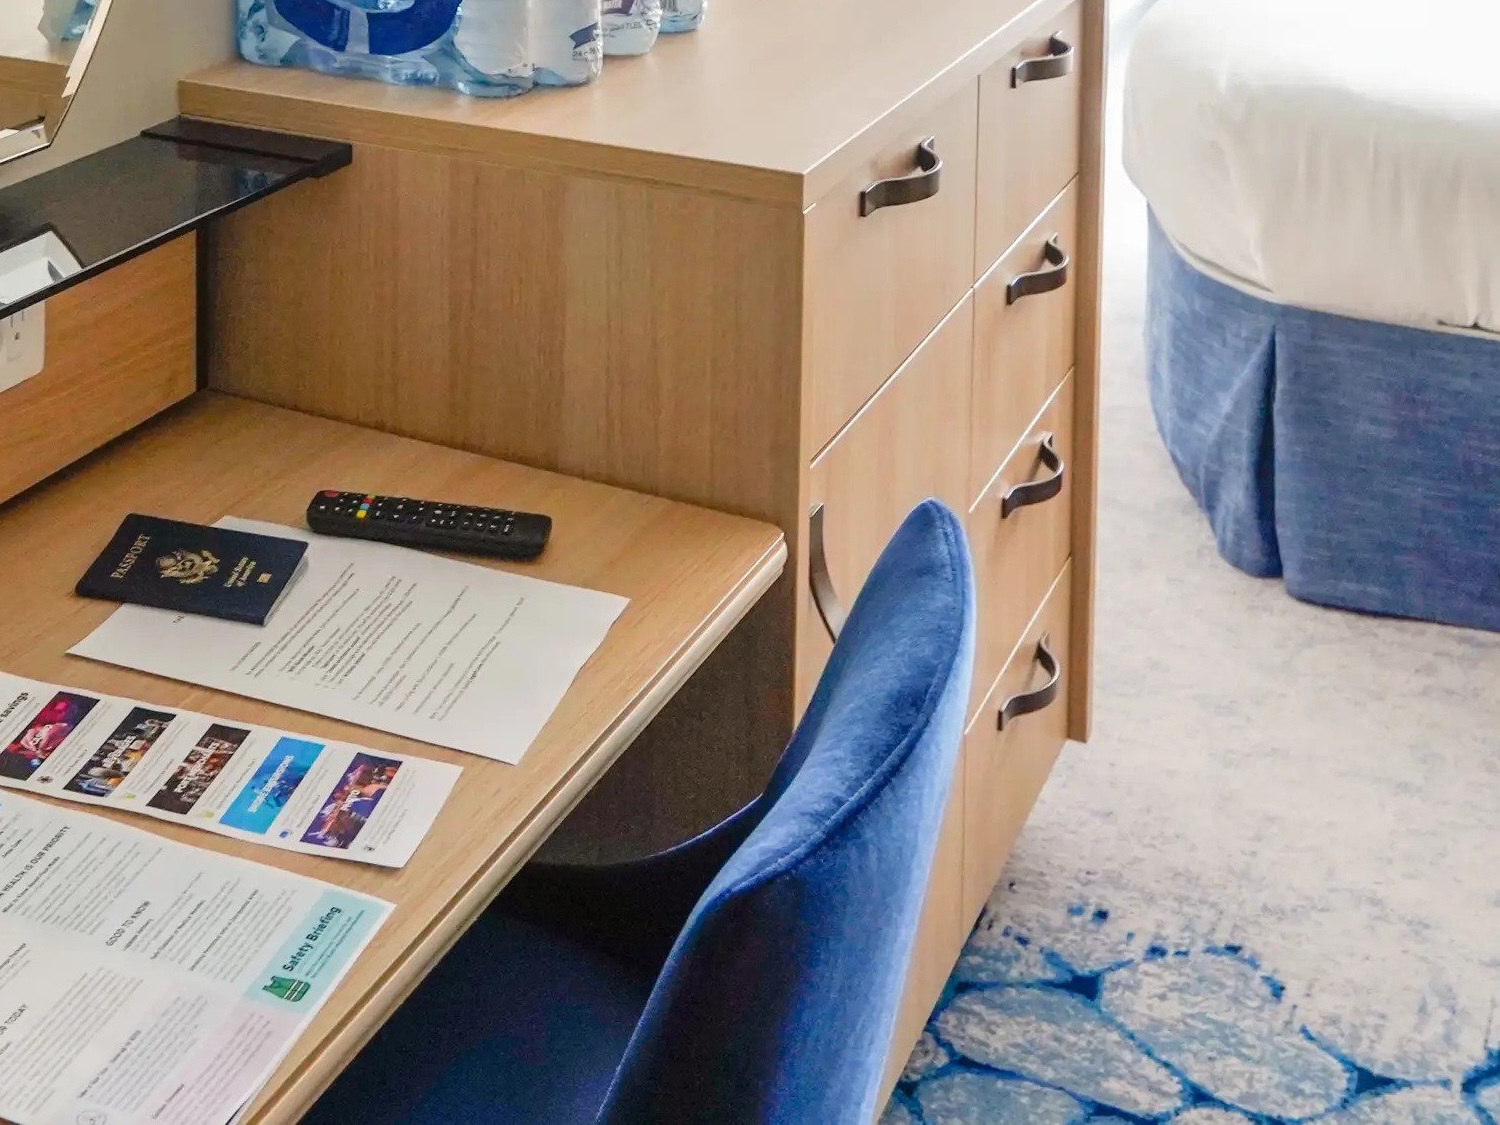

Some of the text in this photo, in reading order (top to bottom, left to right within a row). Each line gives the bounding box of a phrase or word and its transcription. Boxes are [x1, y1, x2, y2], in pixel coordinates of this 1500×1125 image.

[110, 534, 151, 579] PASSPORT
[340, 789, 360, 811] PHOTO
[0, 870, 27, 891] HEALTH
[28, 851, 46, 864] OUR
[40, 825, 71, 851] PRIORITY
[103, 900, 152, 946] GOOD TO KNOW
[280, 940, 315, 972] Safety
[303, 905, 343, 942] Briefing
[3, 1002, 30, 1026] TODAY
